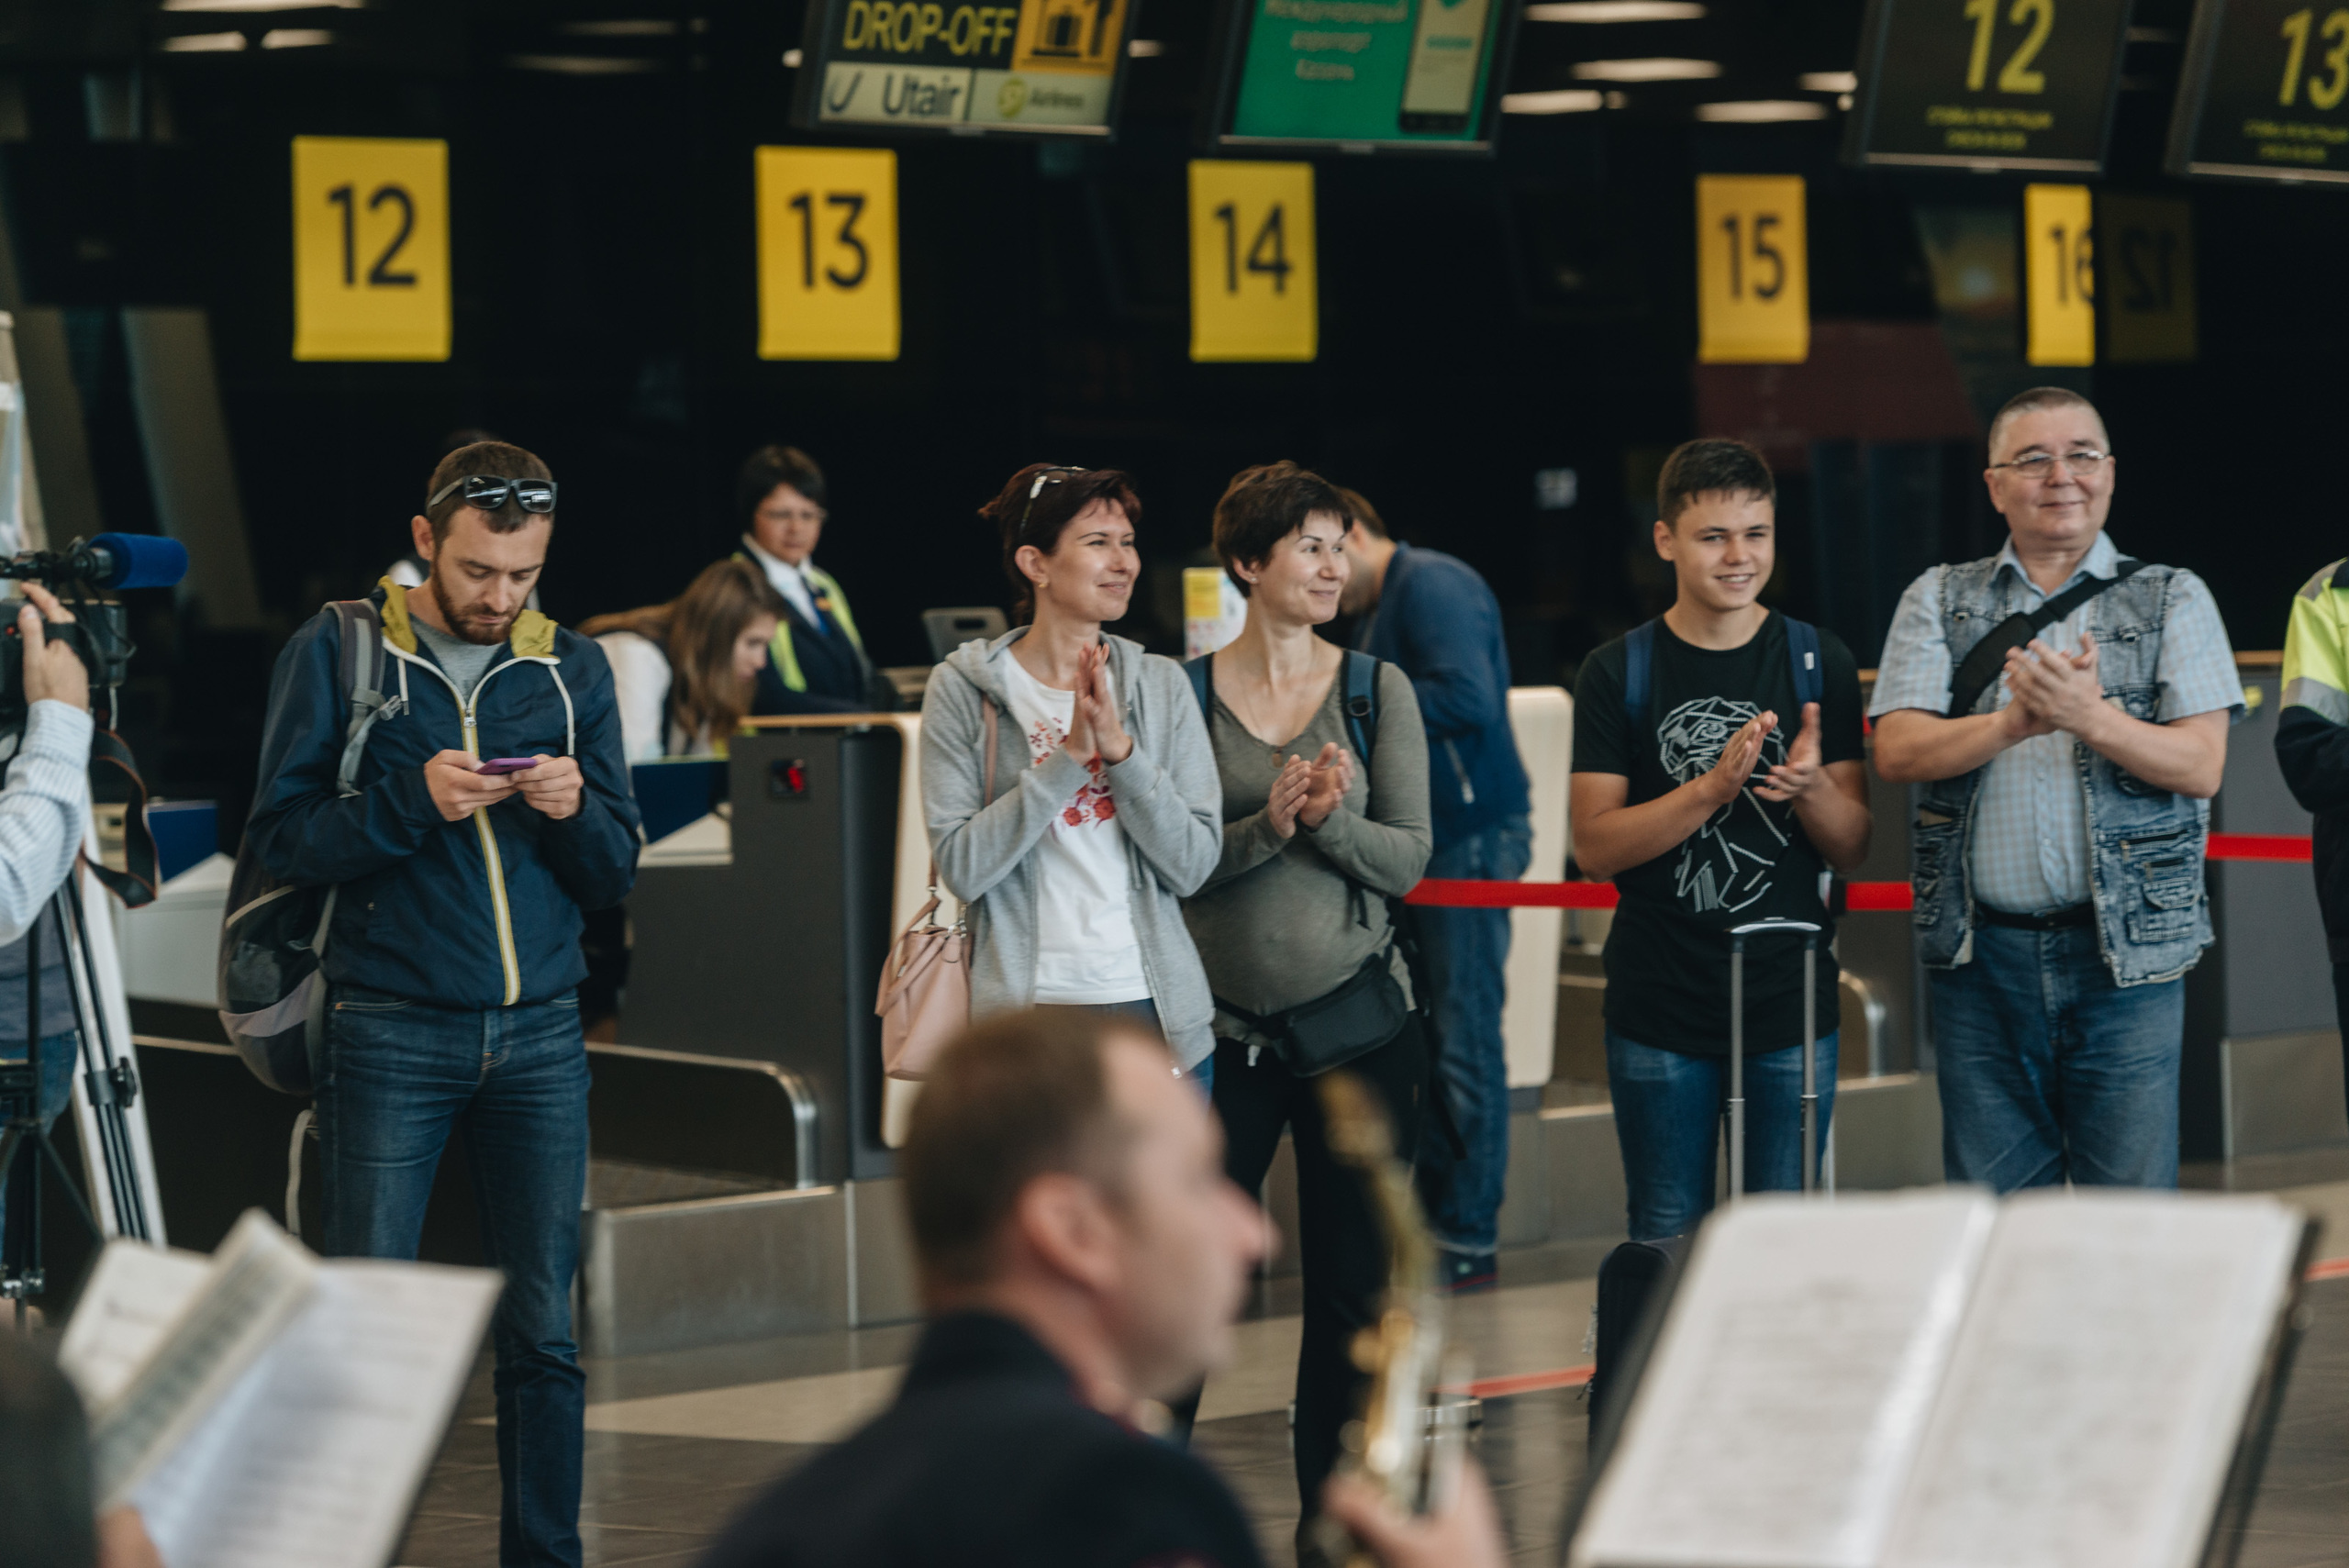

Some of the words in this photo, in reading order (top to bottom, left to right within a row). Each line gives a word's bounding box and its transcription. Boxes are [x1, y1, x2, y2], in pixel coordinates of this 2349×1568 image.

[842, 0, 1019, 56] DROP-OFF
[1963, 0, 2056, 94] 12
[2277, 6, 2349, 110] 13
[882, 72, 963, 117] Utair
[326, 182, 419, 288] 12
[786, 191, 872, 291] 13
[1212, 200, 1295, 295] 14
[1720, 212, 1787, 303] 15
